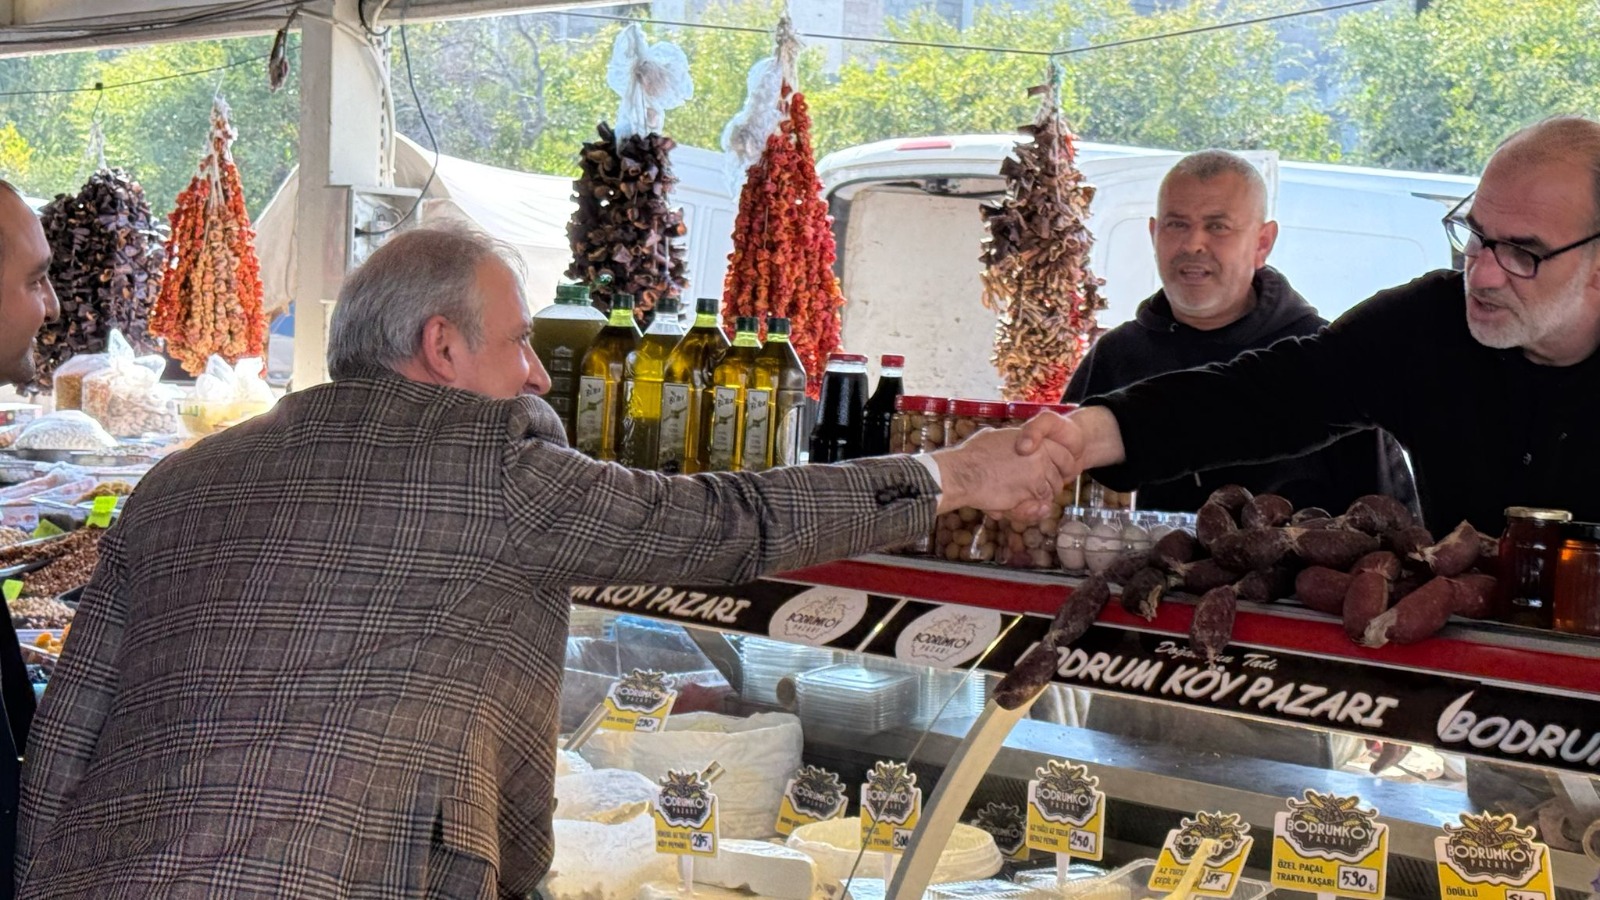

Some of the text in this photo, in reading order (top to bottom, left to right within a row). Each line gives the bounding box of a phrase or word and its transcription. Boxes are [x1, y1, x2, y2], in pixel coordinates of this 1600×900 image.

[646, 587, 752, 623] PAZARI
[1160, 665, 1248, 702] KÖY
[1239, 677, 1399, 728] PAZARI
[1050, 801, 1080, 813] PAZARI
[1308, 834, 1353, 847] PAZARI
[1277, 859, 1325, 875] ÖZEL PAÇAL
[1470, 859, 1515, 870] PAZARI
[1276, 871, 1336, 888] TRAKYA KAŞARI
[1446, 885, 1479, 898] ÖDÜLLÜ
